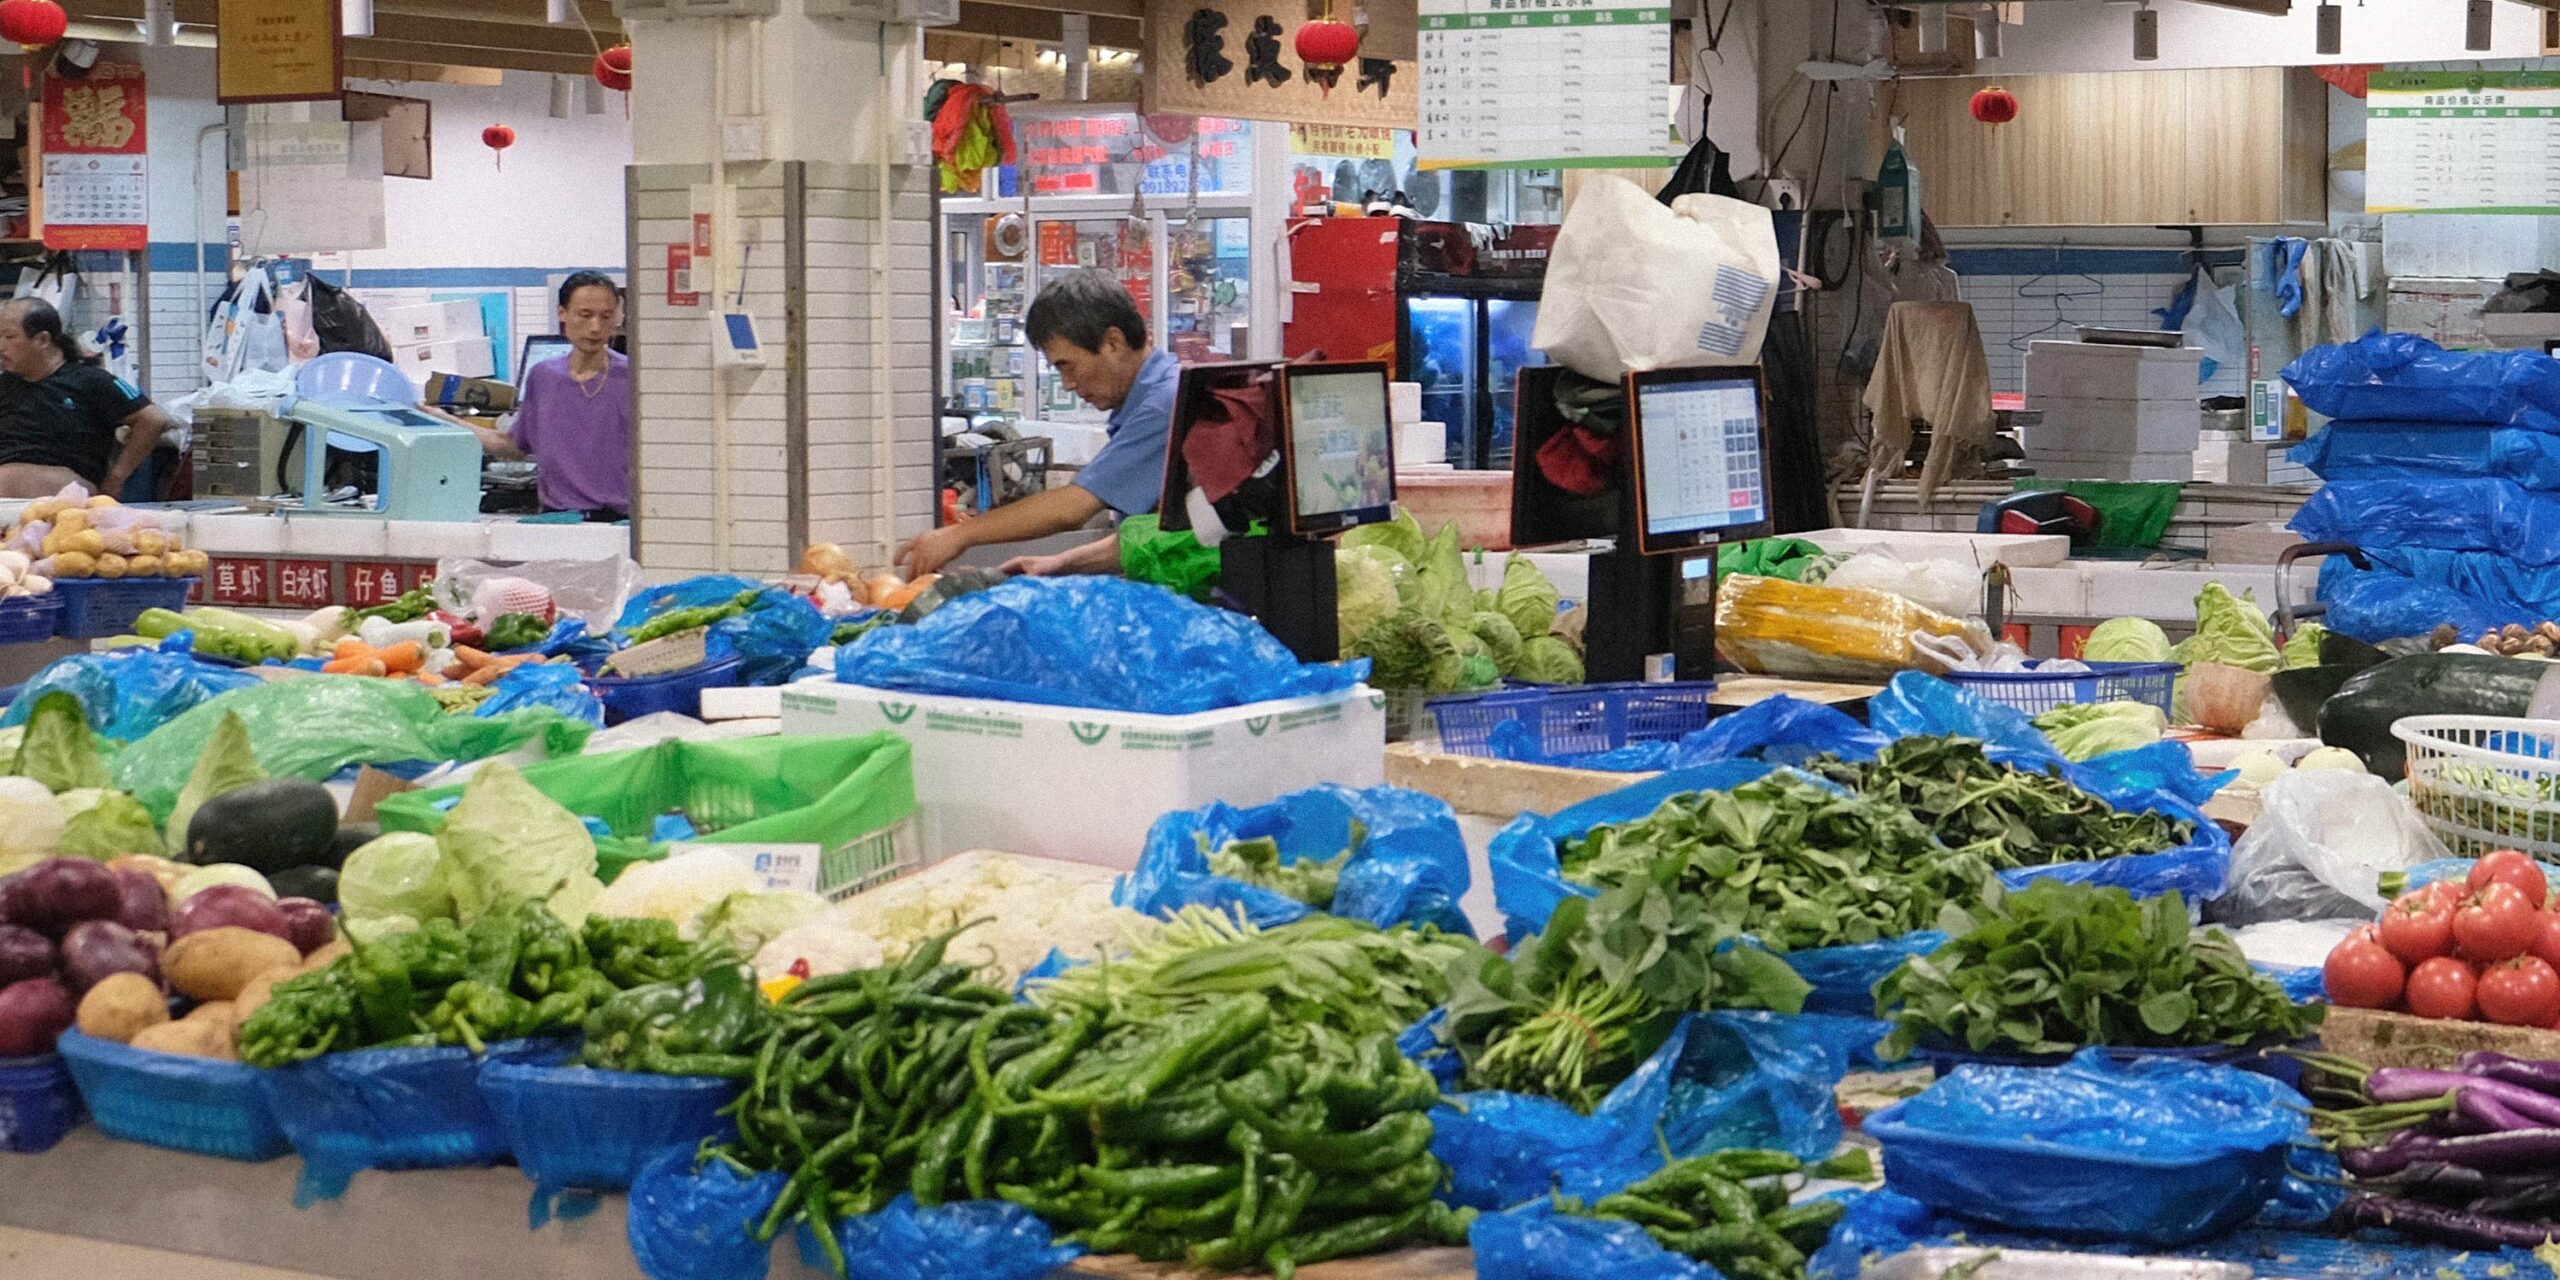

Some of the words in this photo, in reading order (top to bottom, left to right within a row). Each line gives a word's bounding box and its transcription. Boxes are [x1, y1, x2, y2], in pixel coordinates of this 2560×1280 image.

[61, 83, 135, 148] 福
[217, 563, 261, 601] 草虾
[282, 564, 328, 600] 白米虾
[354, 567, 398, 601] 仔鱼
